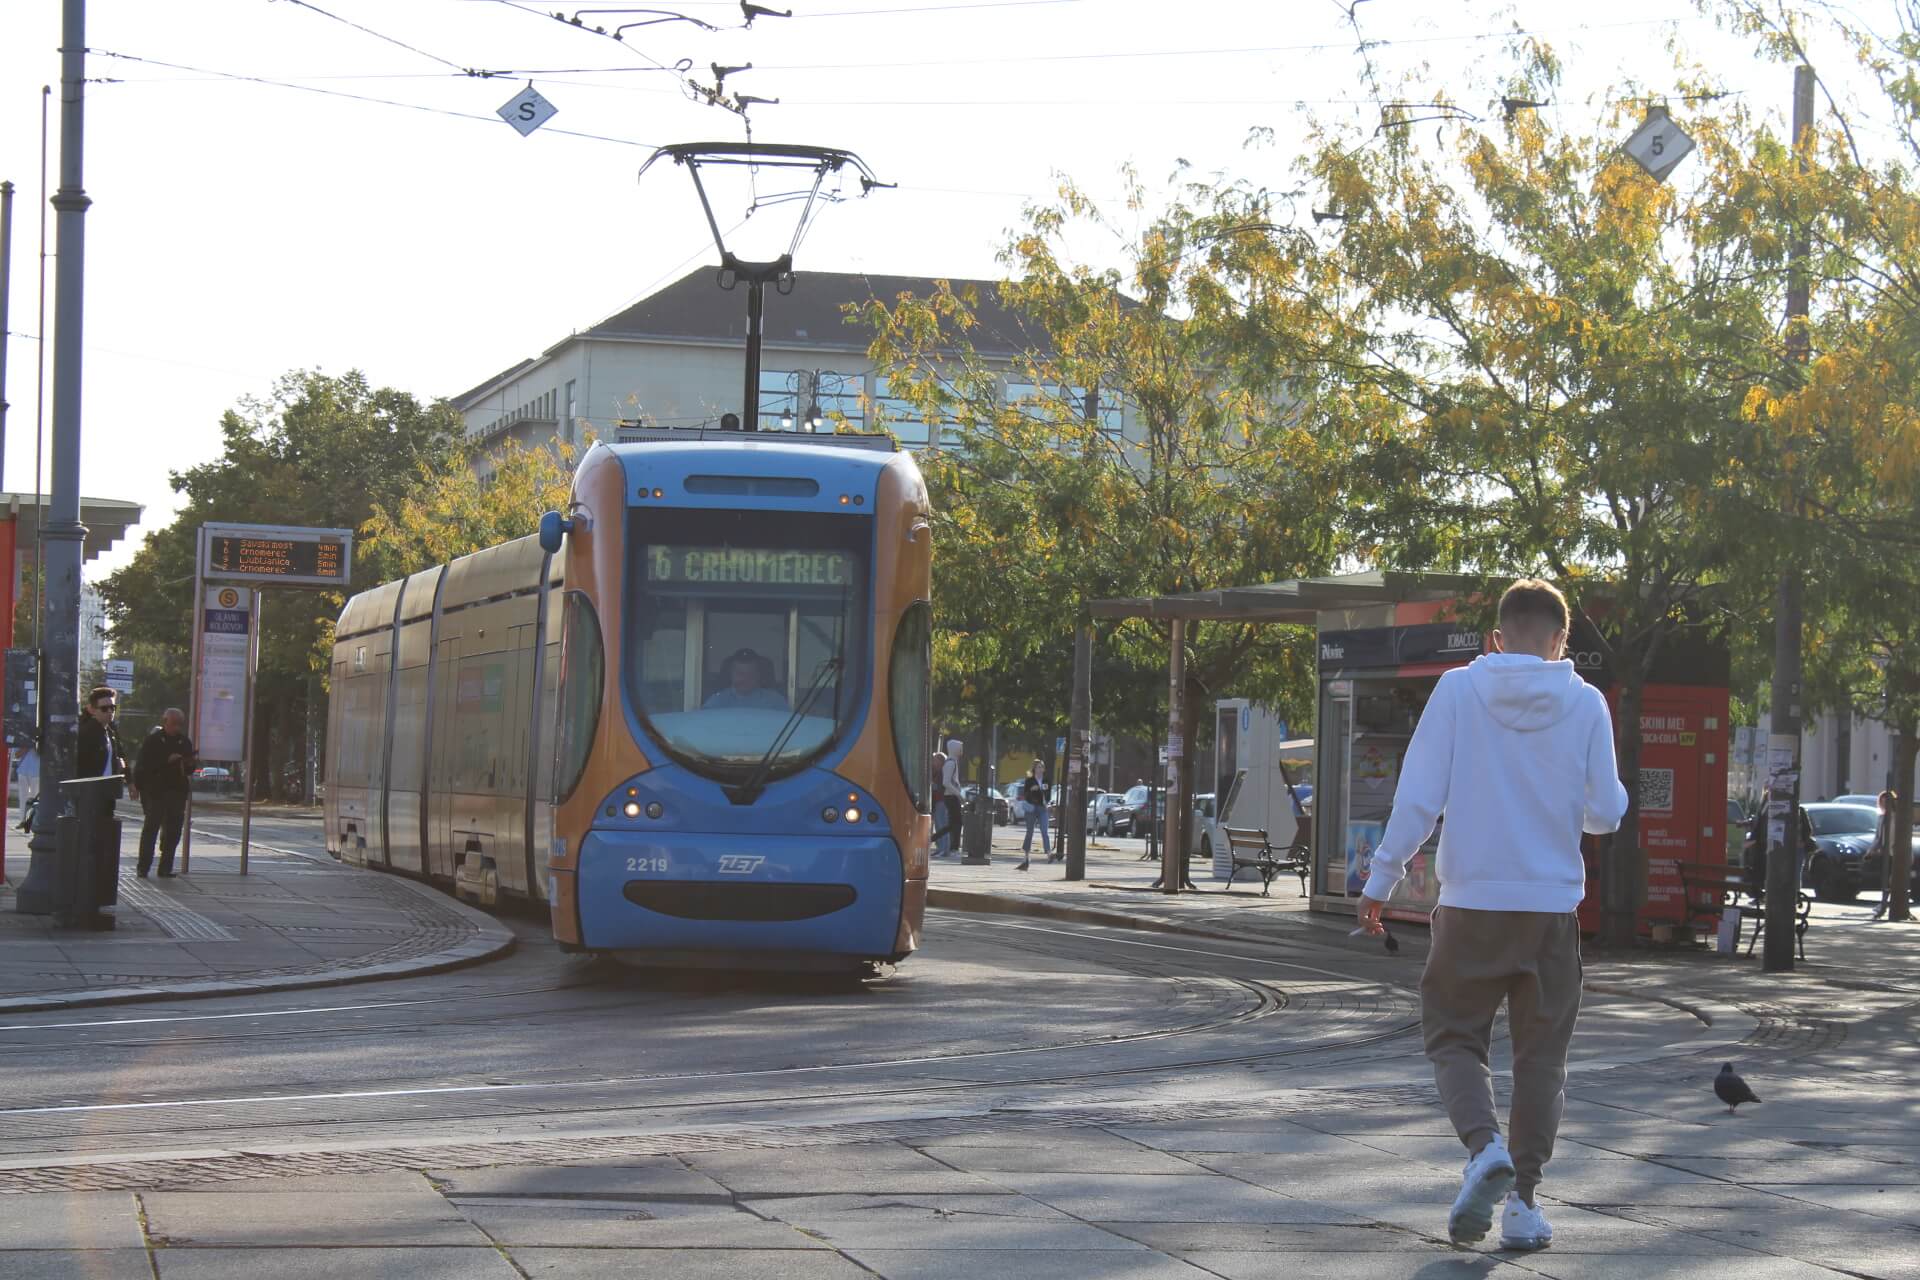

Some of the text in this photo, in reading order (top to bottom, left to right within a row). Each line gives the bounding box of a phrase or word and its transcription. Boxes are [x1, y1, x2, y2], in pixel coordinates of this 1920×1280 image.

[518, 102, 536, 121] S
[1652, 135, 1665, 156] 5
[654, 545, 672, 581] 6
[626, 854, 766, 874] 2219 ZET
